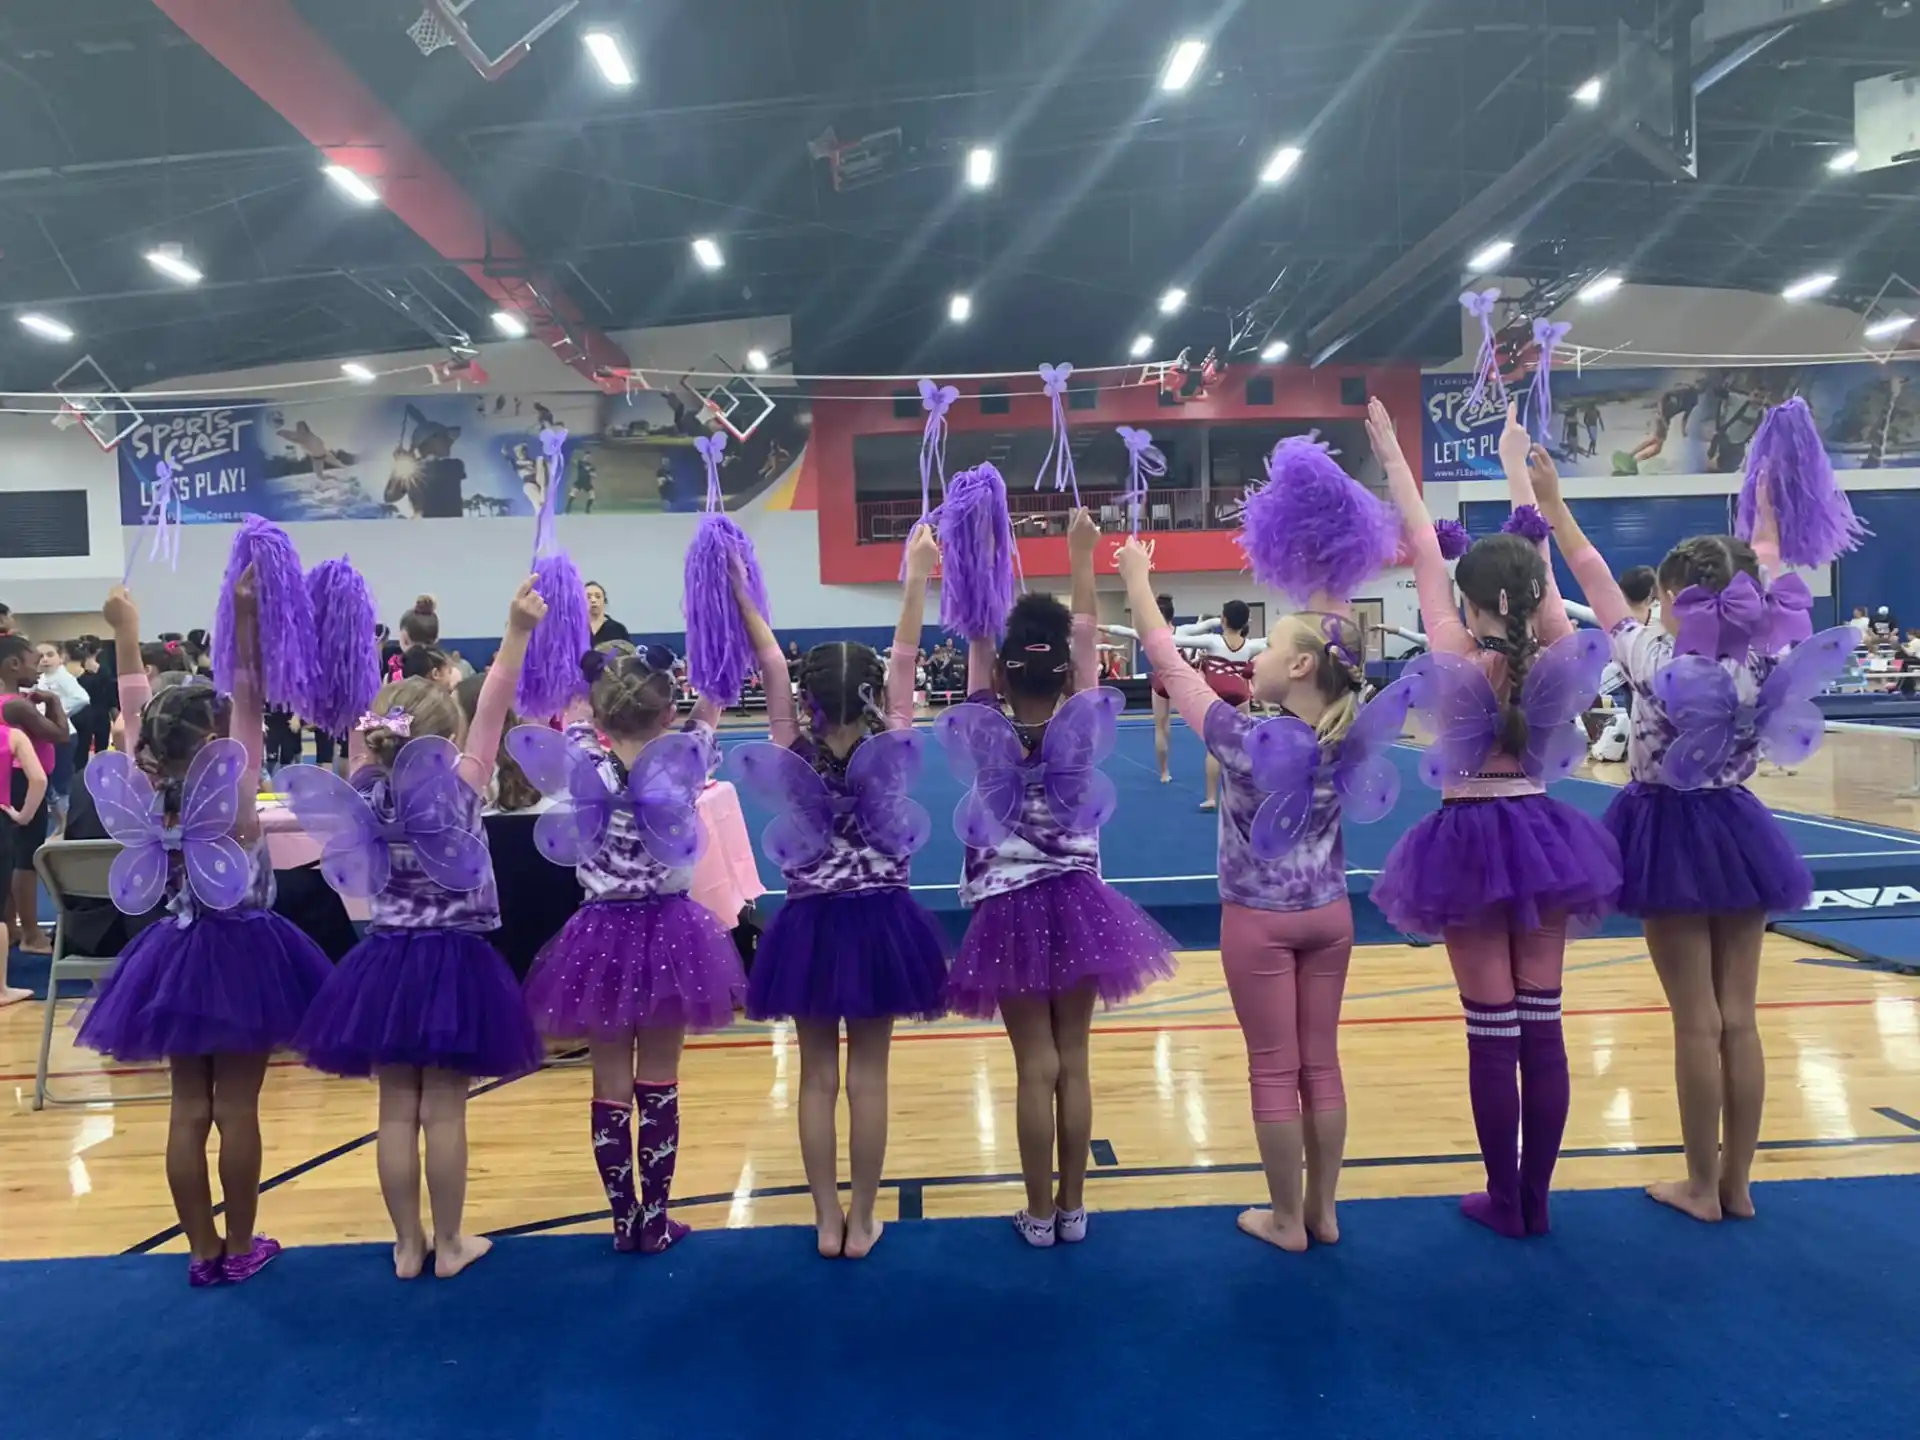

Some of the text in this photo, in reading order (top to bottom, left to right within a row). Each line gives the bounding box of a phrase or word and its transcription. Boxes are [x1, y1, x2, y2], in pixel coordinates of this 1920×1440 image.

[132, 411, 232, 458] SPORTS
[165, 420, 253, 471] COAST
[1434, 438, 1476, 464] LET'S
[195, 467, 246, 498] PLAY!
